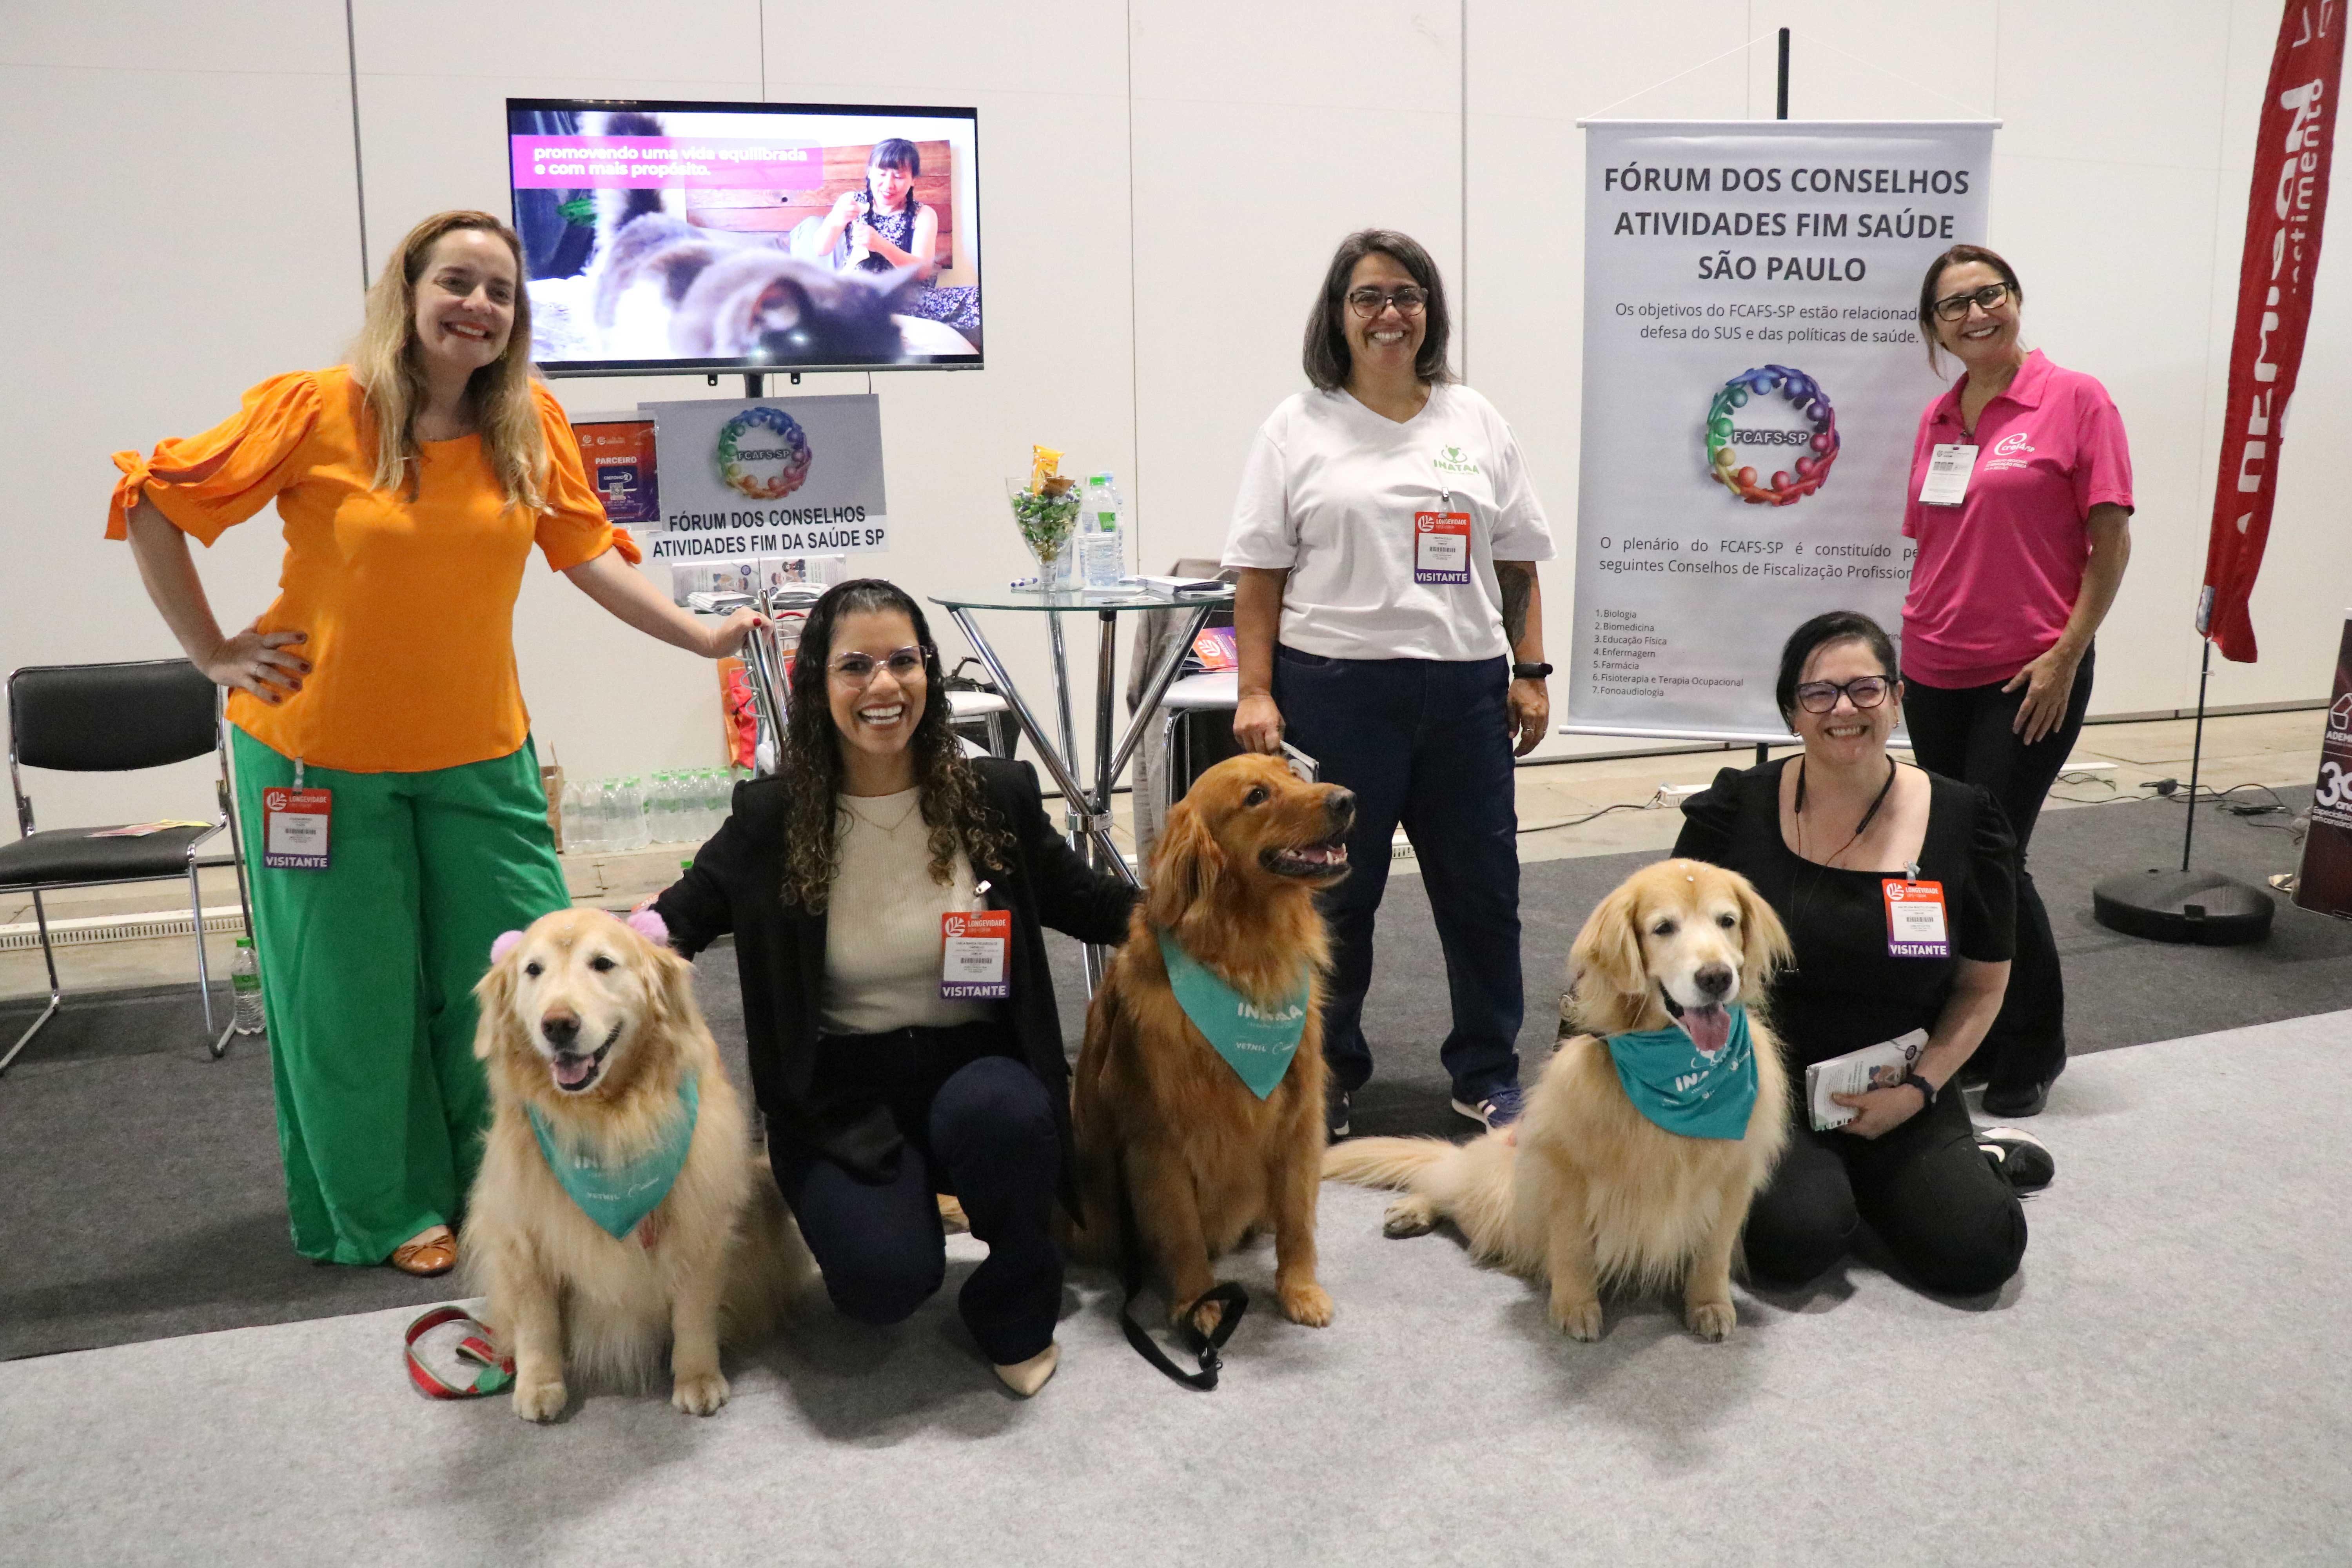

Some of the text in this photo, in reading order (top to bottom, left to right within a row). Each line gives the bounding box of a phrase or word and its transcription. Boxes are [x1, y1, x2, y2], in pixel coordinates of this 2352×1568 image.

[534, 146, 807, 163] promovendo uma vida equilibrada
[534, 161, 711, 178] e com mais propósito.
[1606, 162, 1969, 194] FÓRUM DOS CONSELHOS
[1614, 208, 1954, 239] ATIVIDADES FIM SAÚDE
[1699, 250, 1866, 281] SÃO PAULO
[1616, 303, 1633, 315] Os
[1639, 303, 1702, 319] objetivos
[1707, 304, 1724, 316] do
[1730, 305, 1795, 318] FCAFS-SP
[1800, 306, 1838, 318] estão
[1641, 325, 1918, 344] defesa do SUS e das políticas de saúde.
[1733, 431, 1808, 445] FCAFS-SP
[595, 456, 637, 465] PARCEIRO
[1434, 459, 1479, 474] INATAA
[670, 505, 866, 532] FÓRUM DOS CONSELHOS
[653, 527, 884, 557] ATIVIDADES FIM DA SAÚDE SP
[1601, 537, 1611, 548] O
[1624, 537, 1679, 552] plenário
[1691, 539, 1708, 552] do
[1721, 541, 1783, 554] FCAFS-SP
[1796, 542, 1802, 554] é
[1816, 544, 1891, 557] constituído
[1600, 559, 1663, 573] seguintes
[1669, 560, 1738, 574] Conselhos
[1743, 562, 1759, 575] de
[1764, 563, 1842, 580] Fiscalização
[1416, 573, 1468, 582] VISITANTE
[1604, 610, 1636, 620] Biologia
[1604, 622, 1654, 632] Biomedicina
[1603, 635, 1642, 646] Educação
[1645, 637, 1666, 645] Física
[1602, 648, 1655, 659] Enfermagem
[1602, 661, 1639, 670] Farmácia
[1601, 674, 1648, 684] Fisioterapia
[1659, 676, 1689, 686] Terapia
[1691, 677, 1743, 687] Ocupacional
[1601, 686, 1664, 697] Fonoaudiologia
[266, 856, 327, 867] VISITANTE
[1890, 944, 1947, 955] VISITANTE
[942, 985, 1006, 997] VISITANTE
